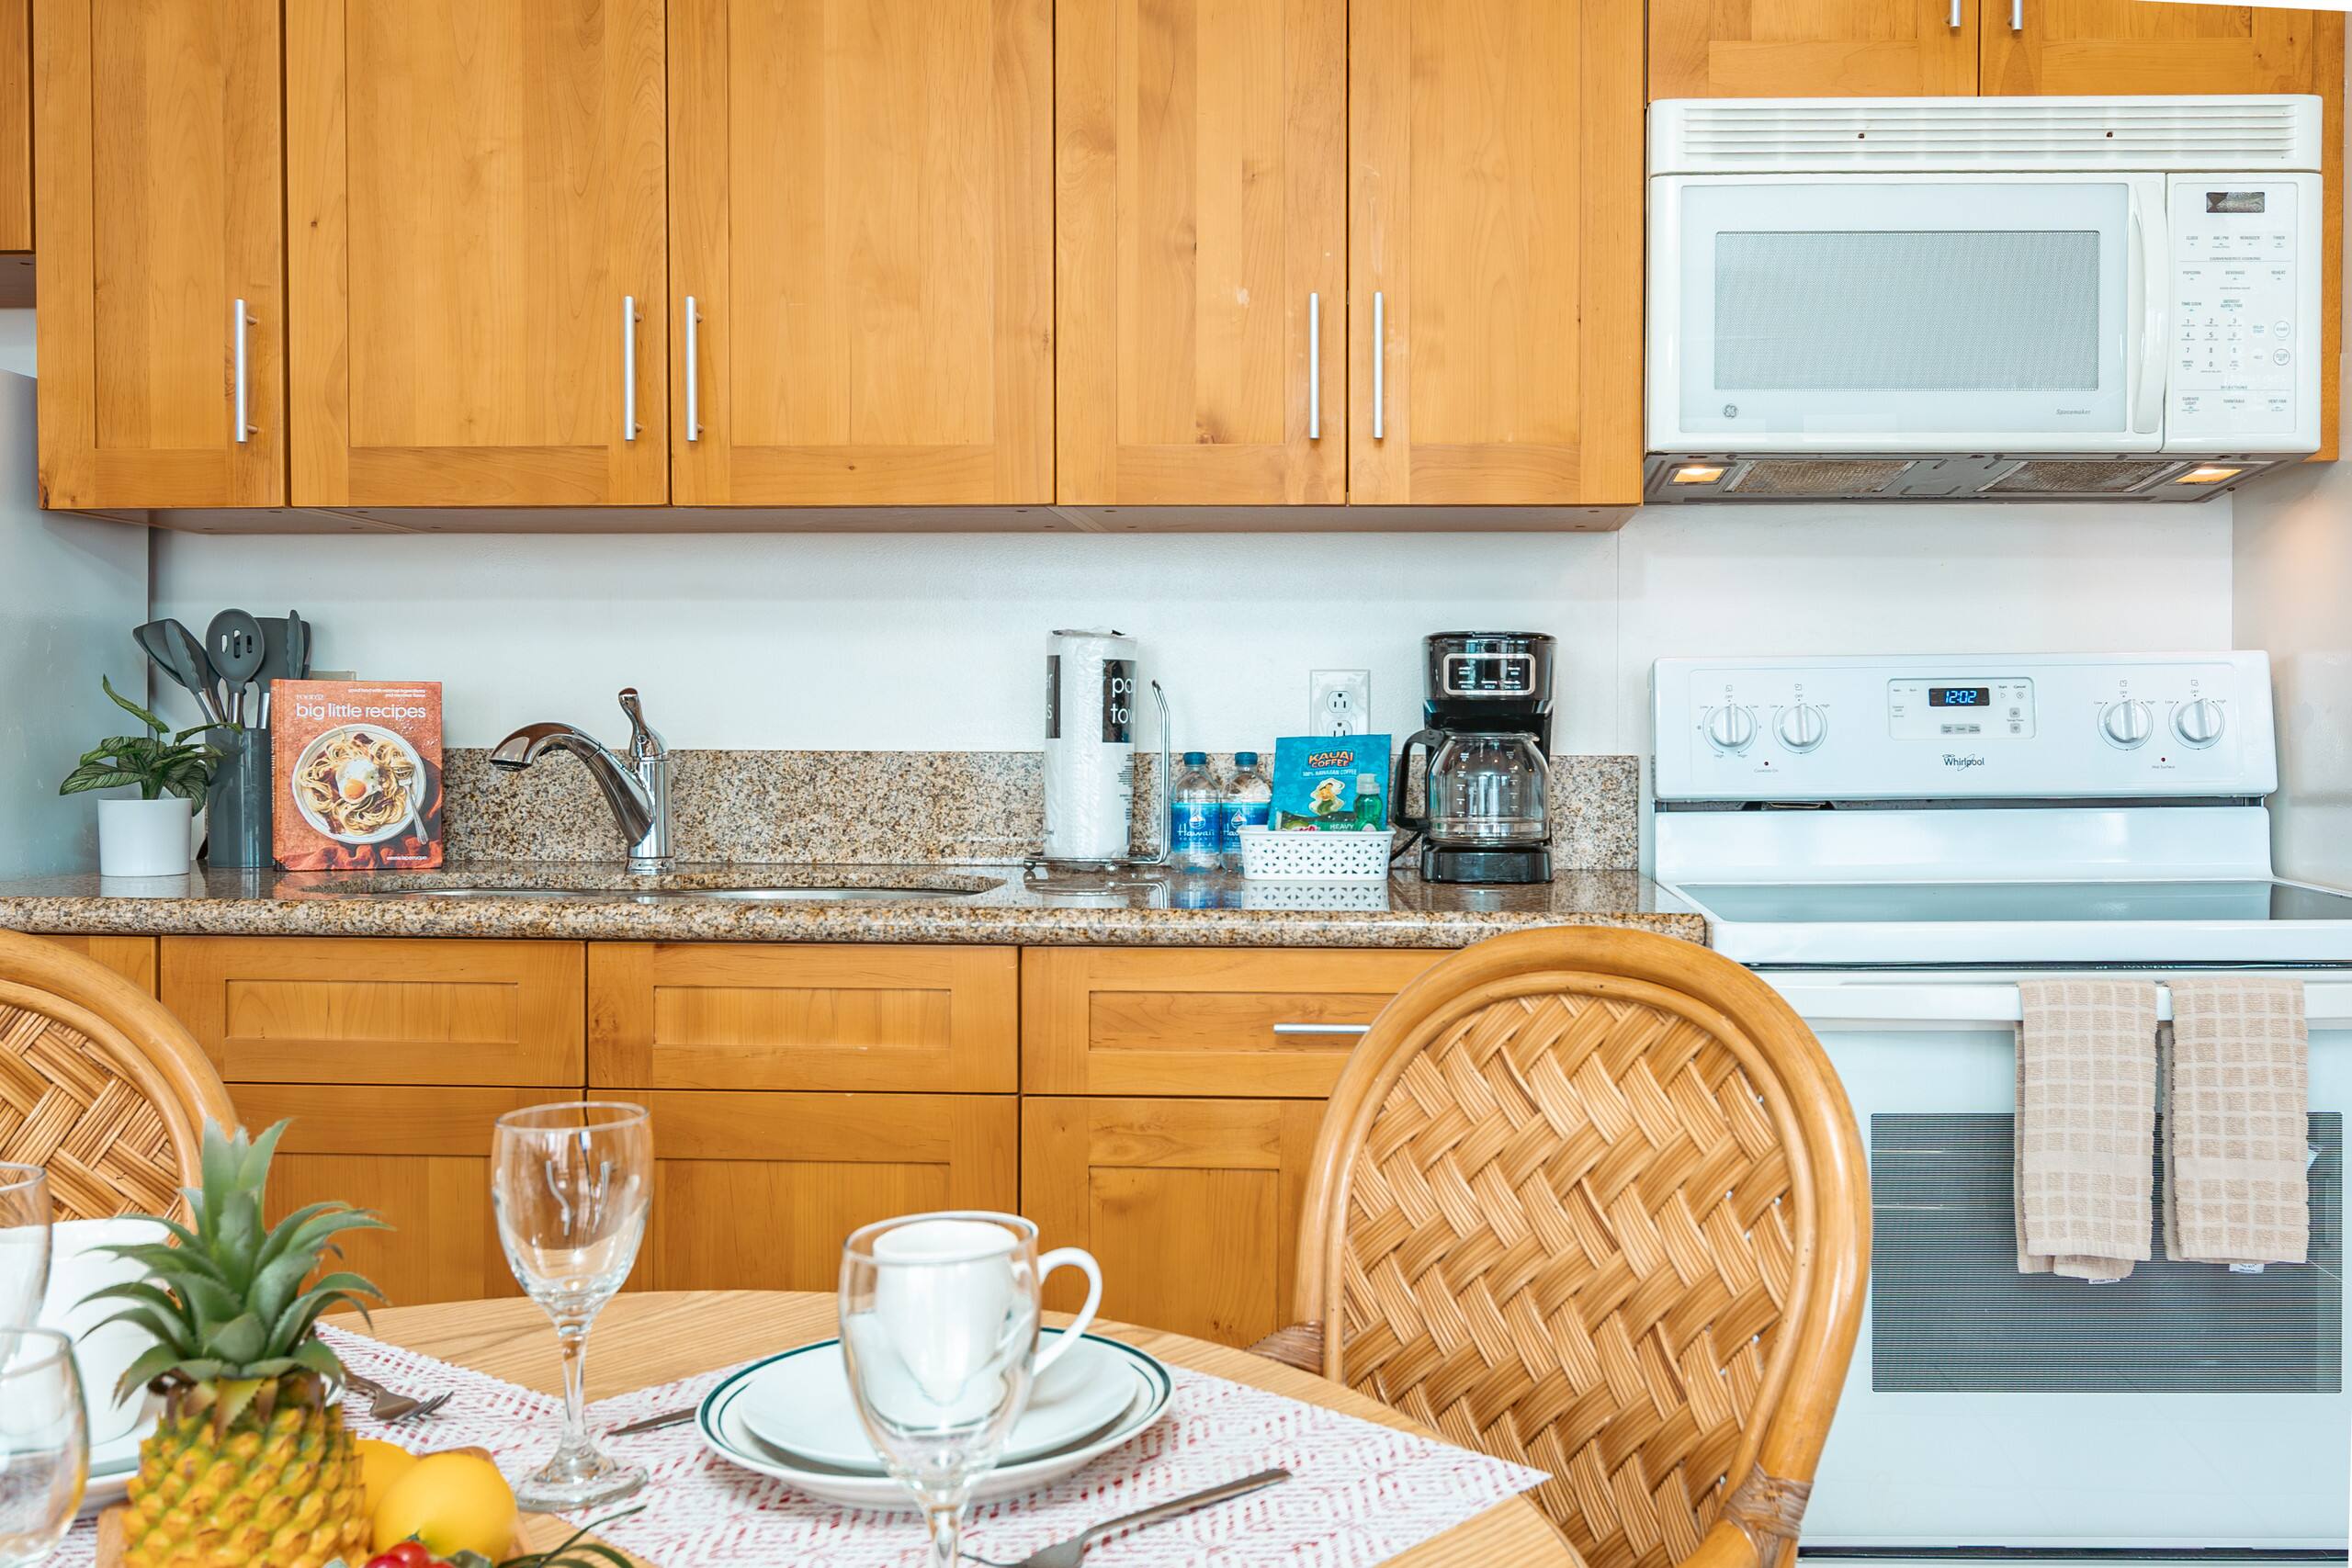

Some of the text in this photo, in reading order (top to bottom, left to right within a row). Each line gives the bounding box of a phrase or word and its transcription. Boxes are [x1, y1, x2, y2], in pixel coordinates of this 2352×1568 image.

[1945, 690, 1977, 704] 12:02
[296, 702, 426, 722] big little recipes
[1308, 750, 1354, 765] KAUAI
[1311, 758, 1351, 769] COFFEE
[1942, 755, 1984, 769] Whirlpool
